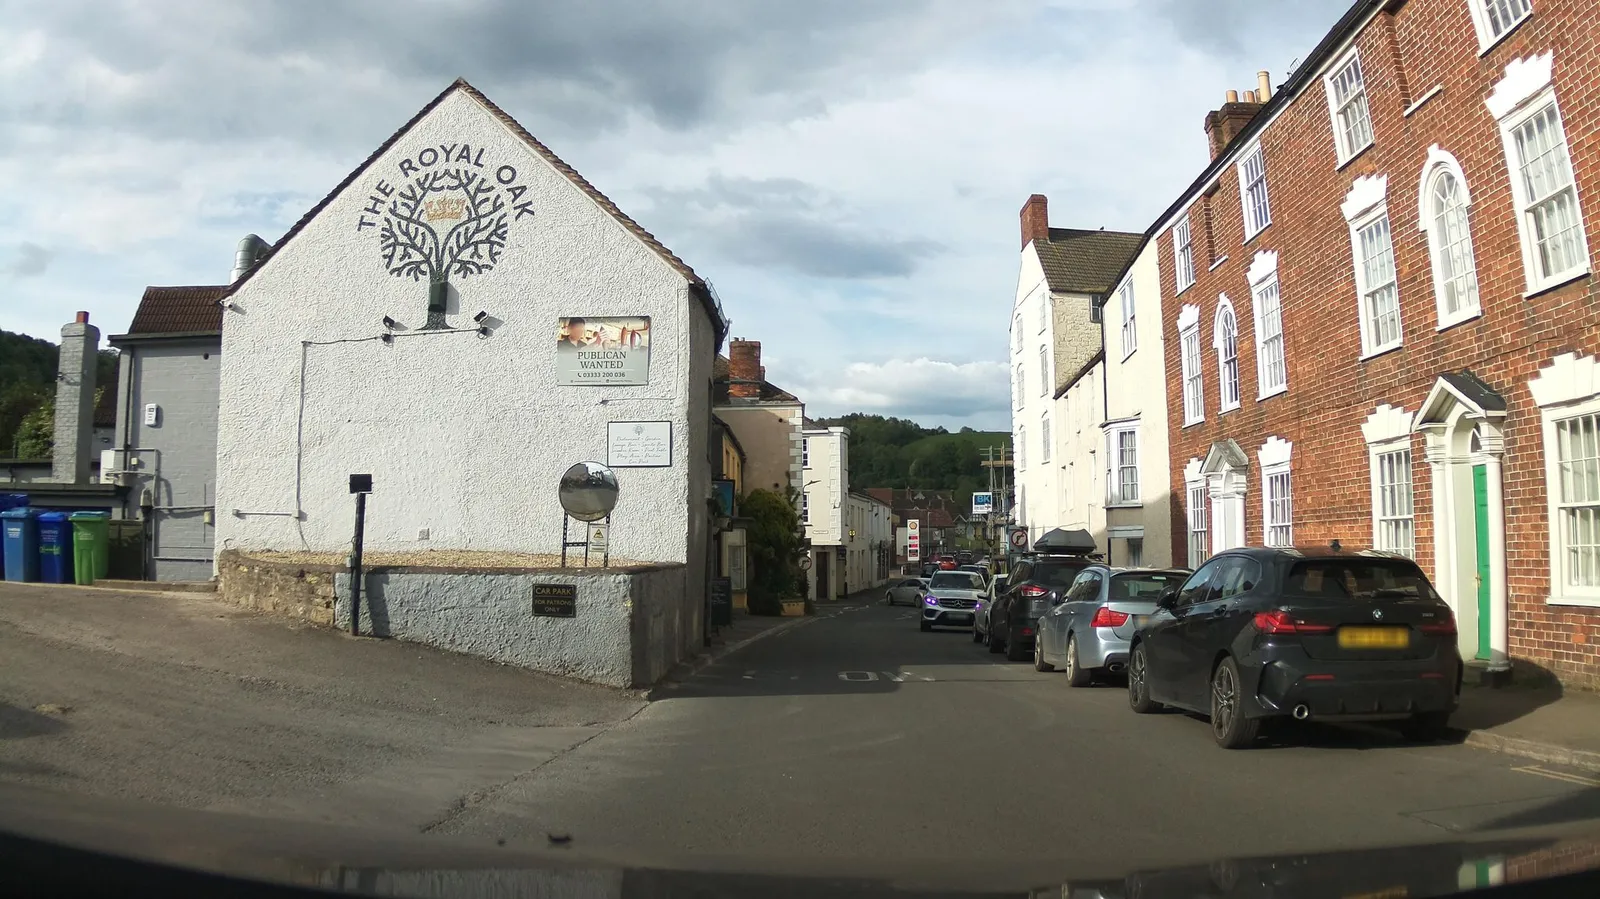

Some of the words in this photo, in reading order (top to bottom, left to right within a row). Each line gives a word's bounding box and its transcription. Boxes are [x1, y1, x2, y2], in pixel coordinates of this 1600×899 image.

[357, 178, 395, 232] THE
[398, 143, 485, 178] ROYAL
[496, 164, 535, 221] OAK
[578, 351, 626, 359] PUBLICAN
